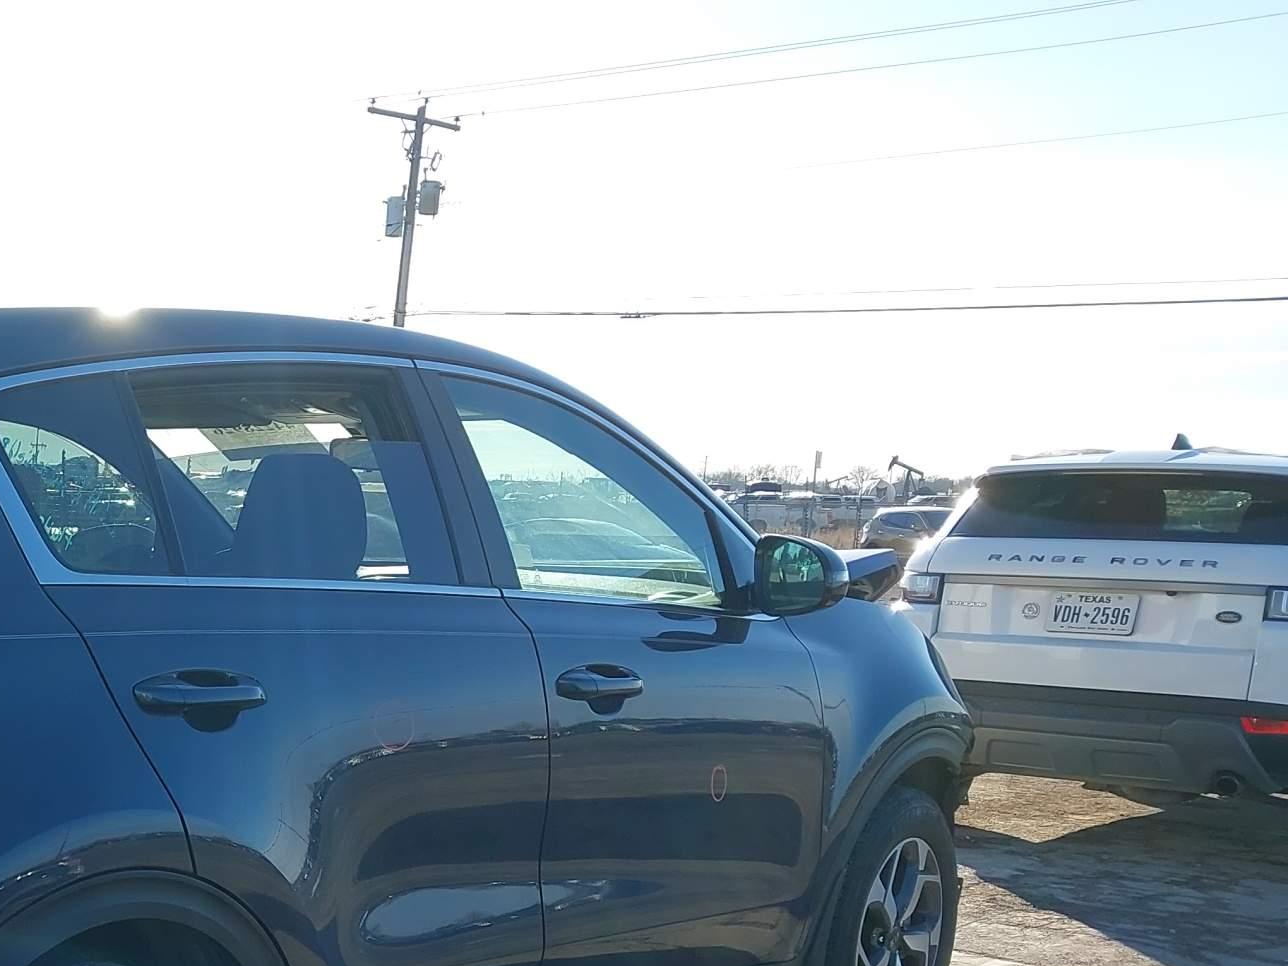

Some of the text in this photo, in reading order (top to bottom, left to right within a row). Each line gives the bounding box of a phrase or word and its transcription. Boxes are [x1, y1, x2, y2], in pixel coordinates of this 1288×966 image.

[987, 554, 1219, 568] RANGE ROVER
[1079, 595, 1112, 603] TEXAS
